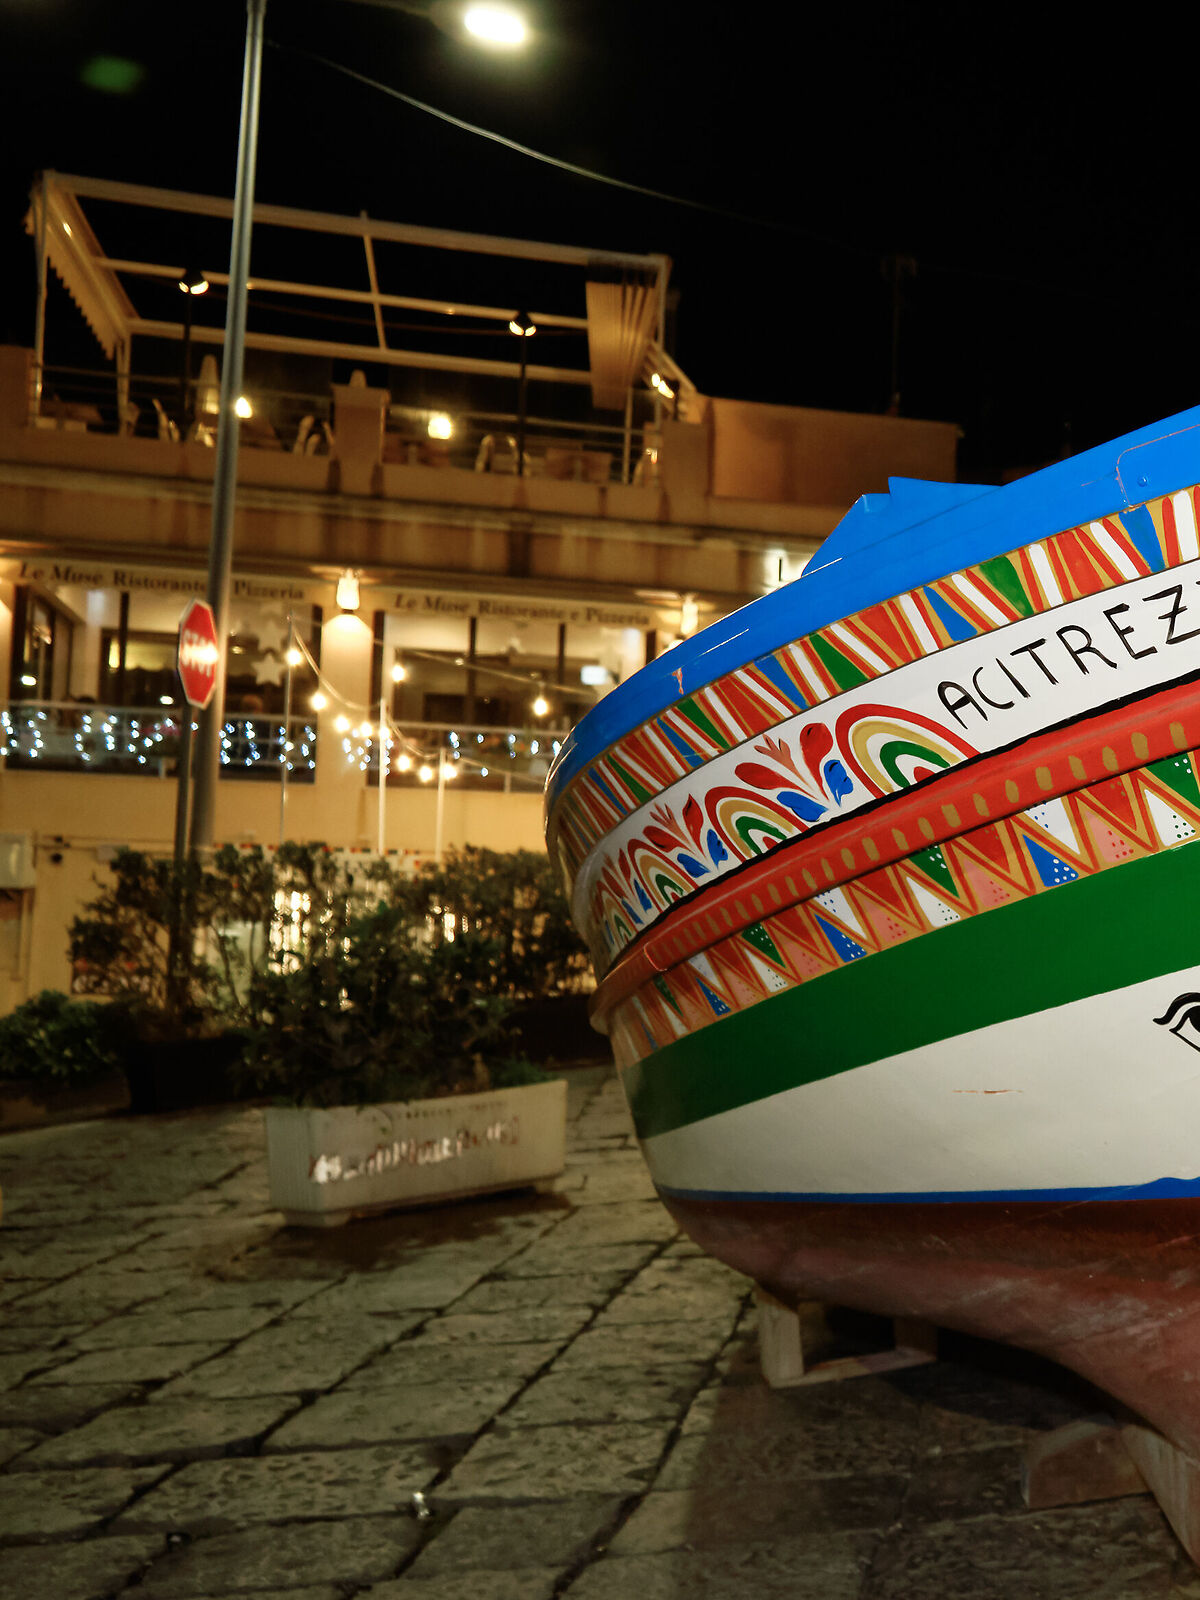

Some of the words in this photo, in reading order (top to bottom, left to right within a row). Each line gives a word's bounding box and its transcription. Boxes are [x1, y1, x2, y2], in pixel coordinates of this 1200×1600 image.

[19, 561, 44, 580] Le
[51, 564, 103, 586] Muse
[233, 579, 304, 600] Pizzeria
[395, 593, 416, 610] Le
[586, 606, 649, 626] Pizzeria
